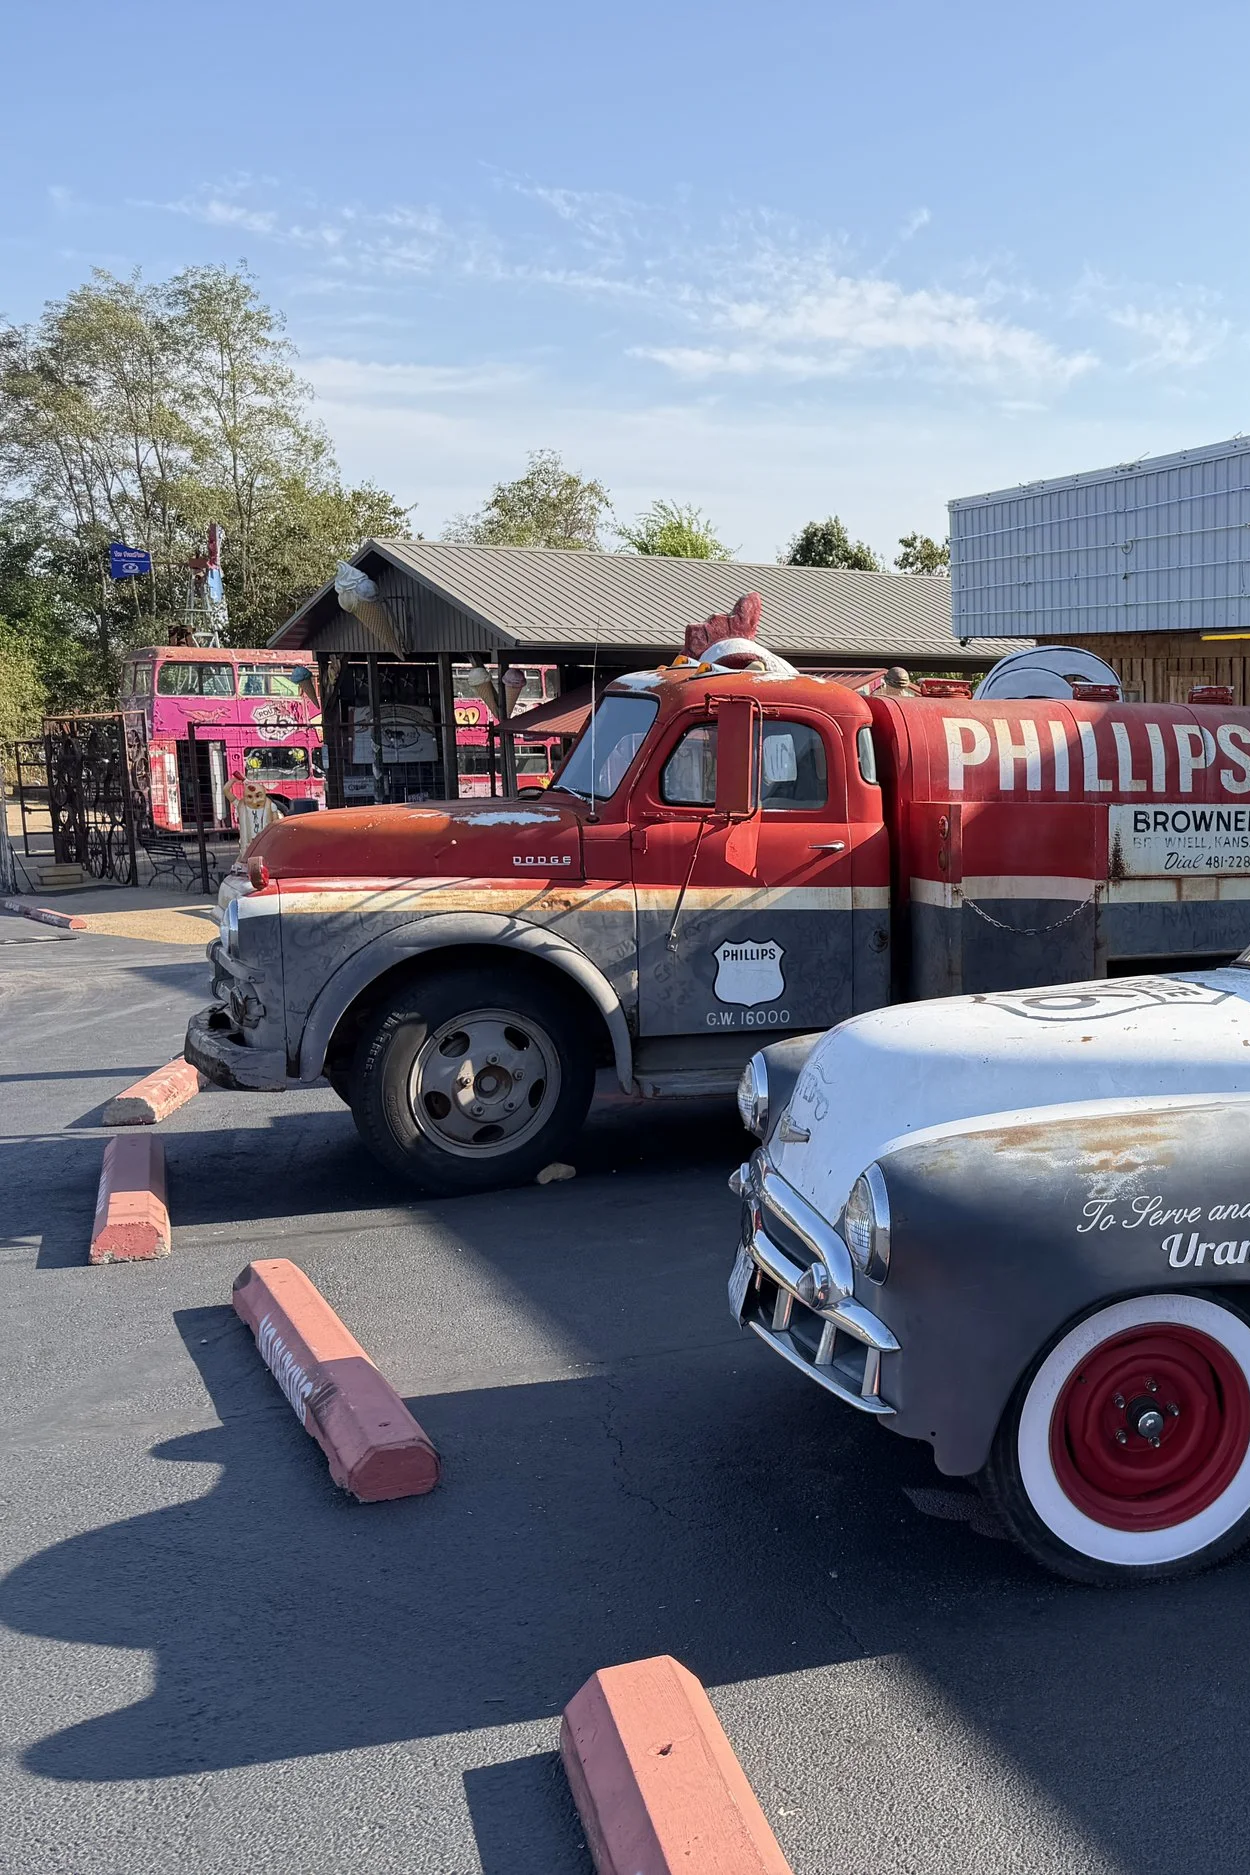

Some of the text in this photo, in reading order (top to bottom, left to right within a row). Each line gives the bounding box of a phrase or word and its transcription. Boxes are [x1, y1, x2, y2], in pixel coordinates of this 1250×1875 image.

[512, 856, 572, 864] DODGE
[1164, 852, 1204, 870] Dial
[722, 948, 776, 961] PHILLIPS
[706, 1010, 790, 1026] G.W. 16000
[1076, 1199, 1117, 1233] To
[1122, 1195, 1201, 1229] Serve
